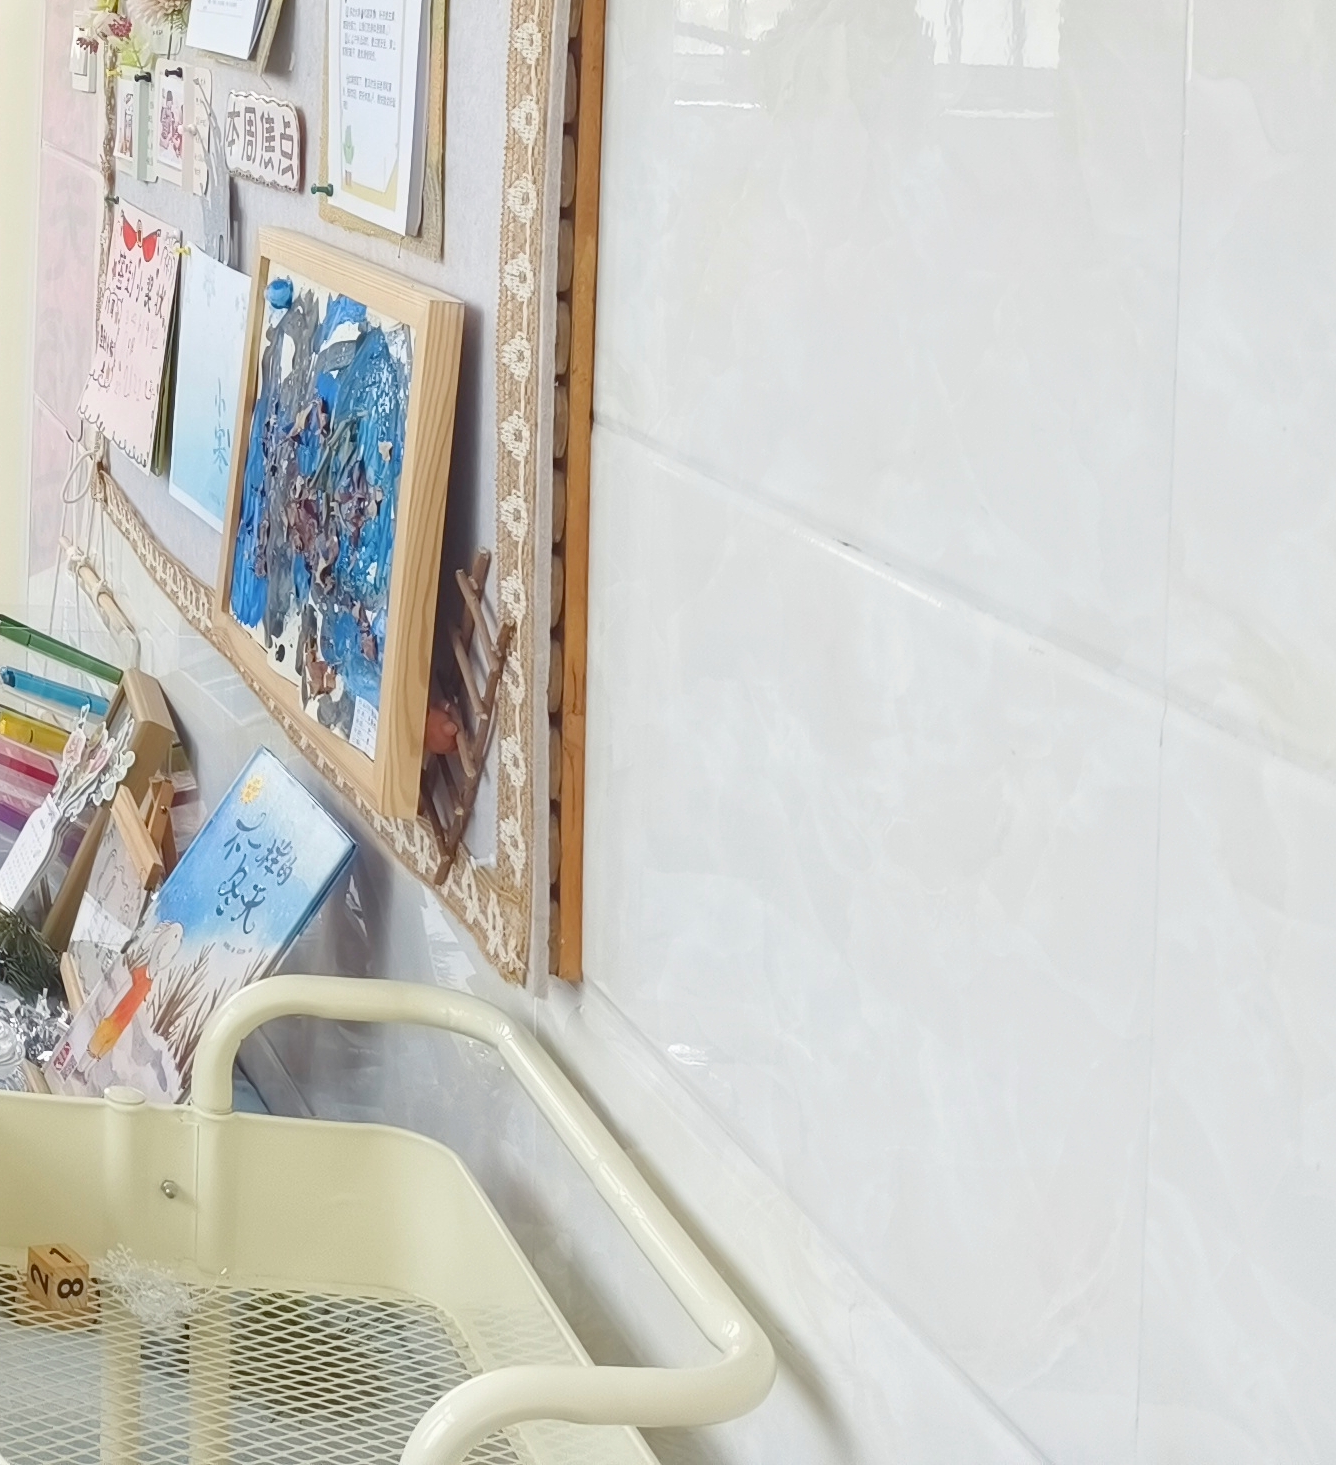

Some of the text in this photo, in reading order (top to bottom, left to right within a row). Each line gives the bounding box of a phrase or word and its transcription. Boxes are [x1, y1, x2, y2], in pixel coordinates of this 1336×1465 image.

[225, 99, 296, 181] 本周焦点
[57, 1277, 84, 1299] 8
